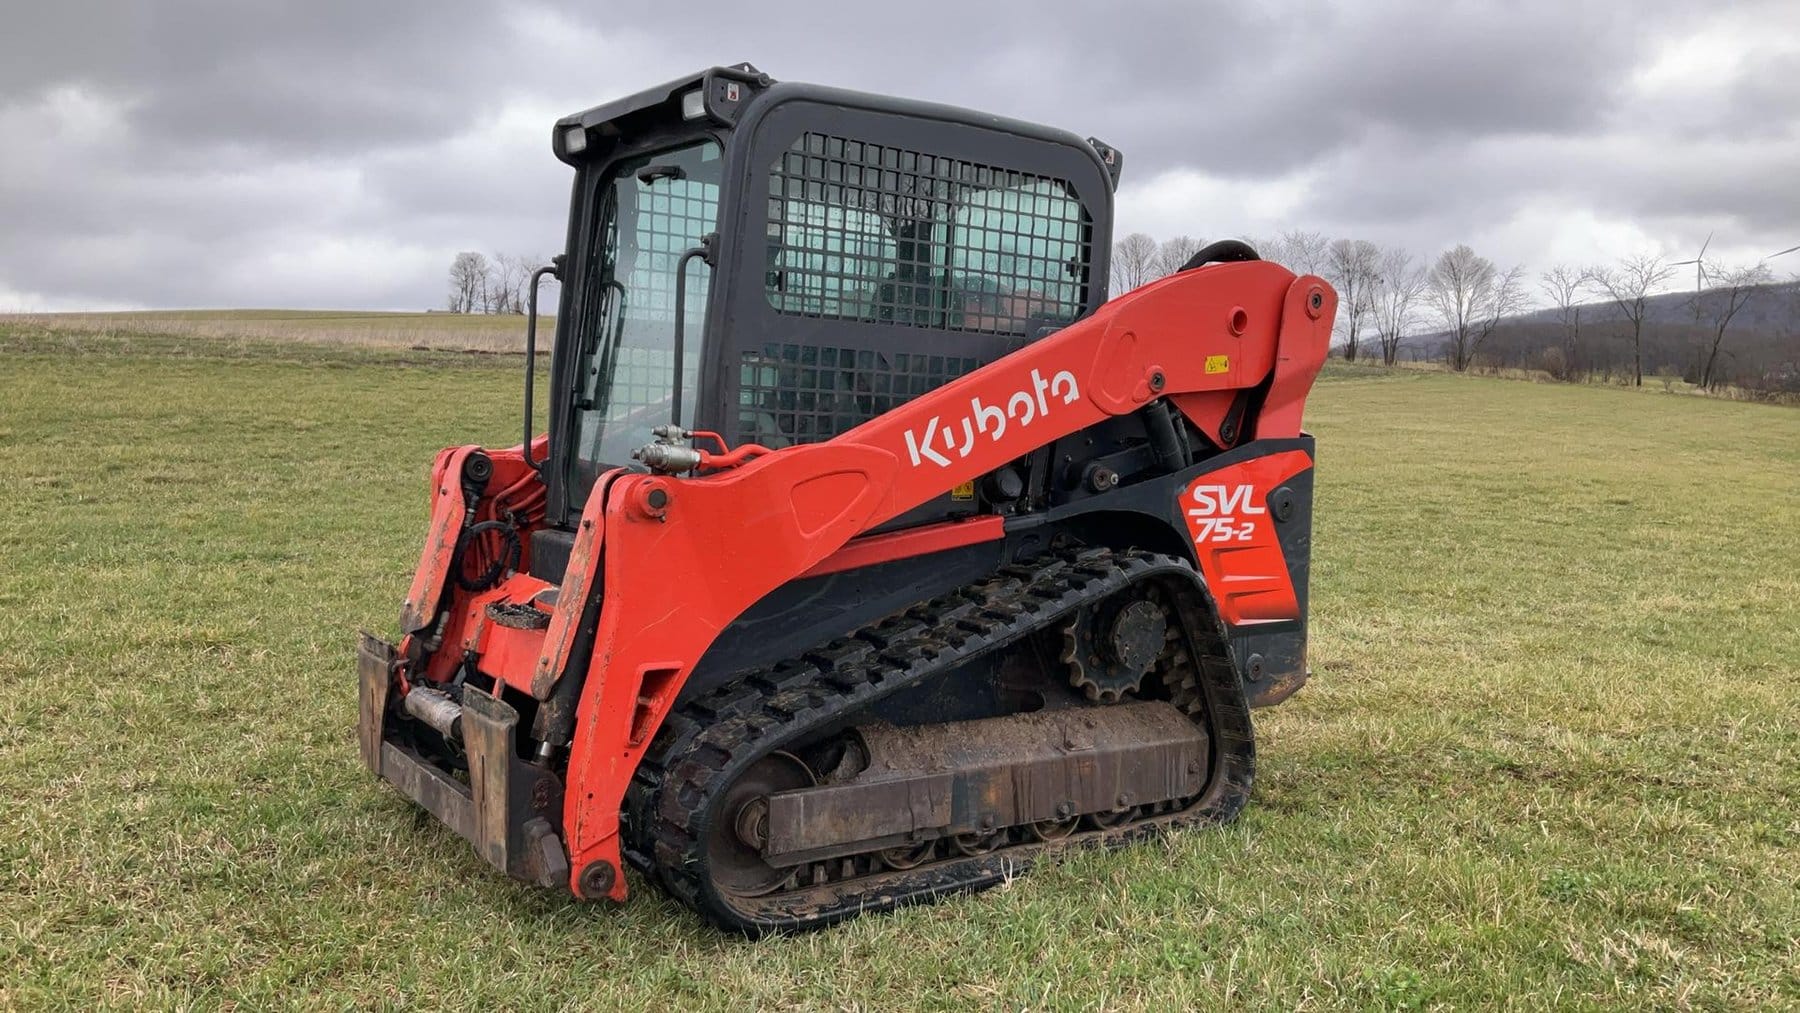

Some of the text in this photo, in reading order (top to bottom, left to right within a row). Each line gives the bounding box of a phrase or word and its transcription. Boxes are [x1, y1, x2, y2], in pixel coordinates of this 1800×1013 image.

[904, 368, 1080, 468] Kubota
[1188, 484, 1266, 516] SVL
[1194, 517, 1256, 543] 75-2
